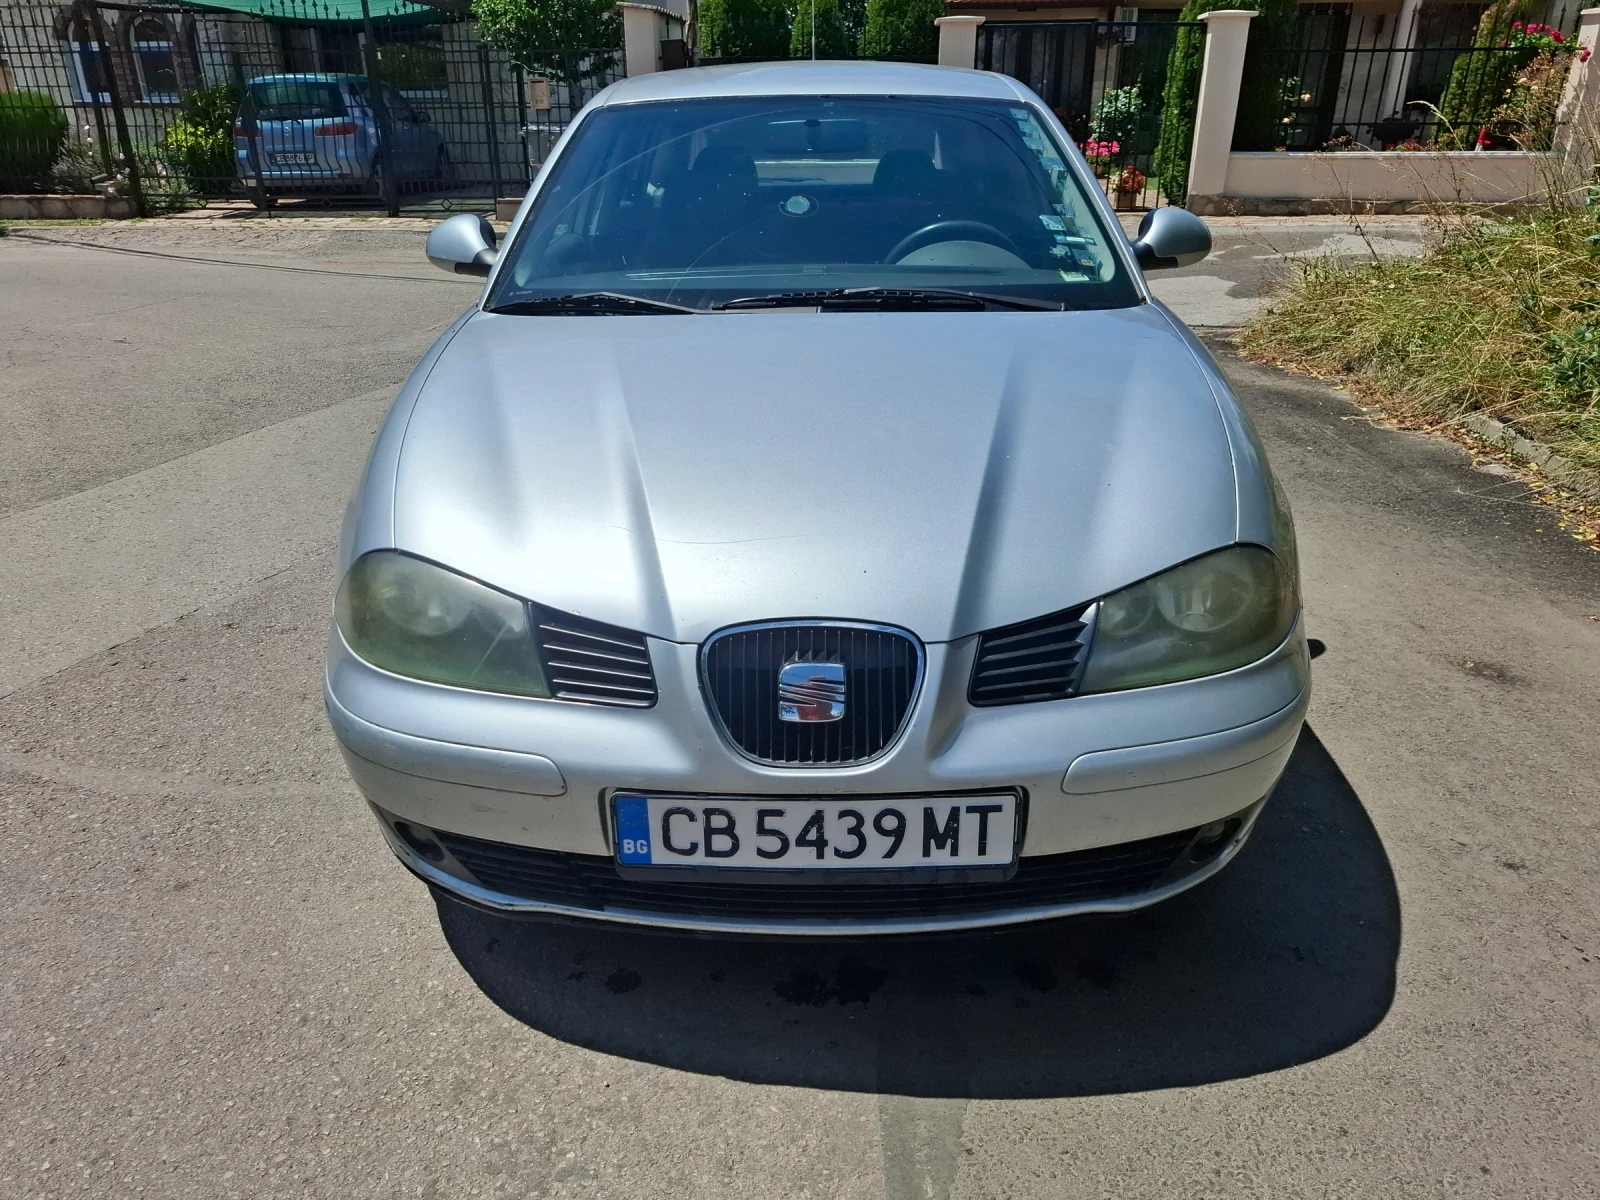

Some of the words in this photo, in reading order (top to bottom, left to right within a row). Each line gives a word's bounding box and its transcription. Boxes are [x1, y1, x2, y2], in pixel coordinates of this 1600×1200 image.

[623, 839, 648, 854] BG
[661, 806, 740, 859] CB
[756, 808, 907, 860] 5439
[922, 805, 1003, 858] MT
